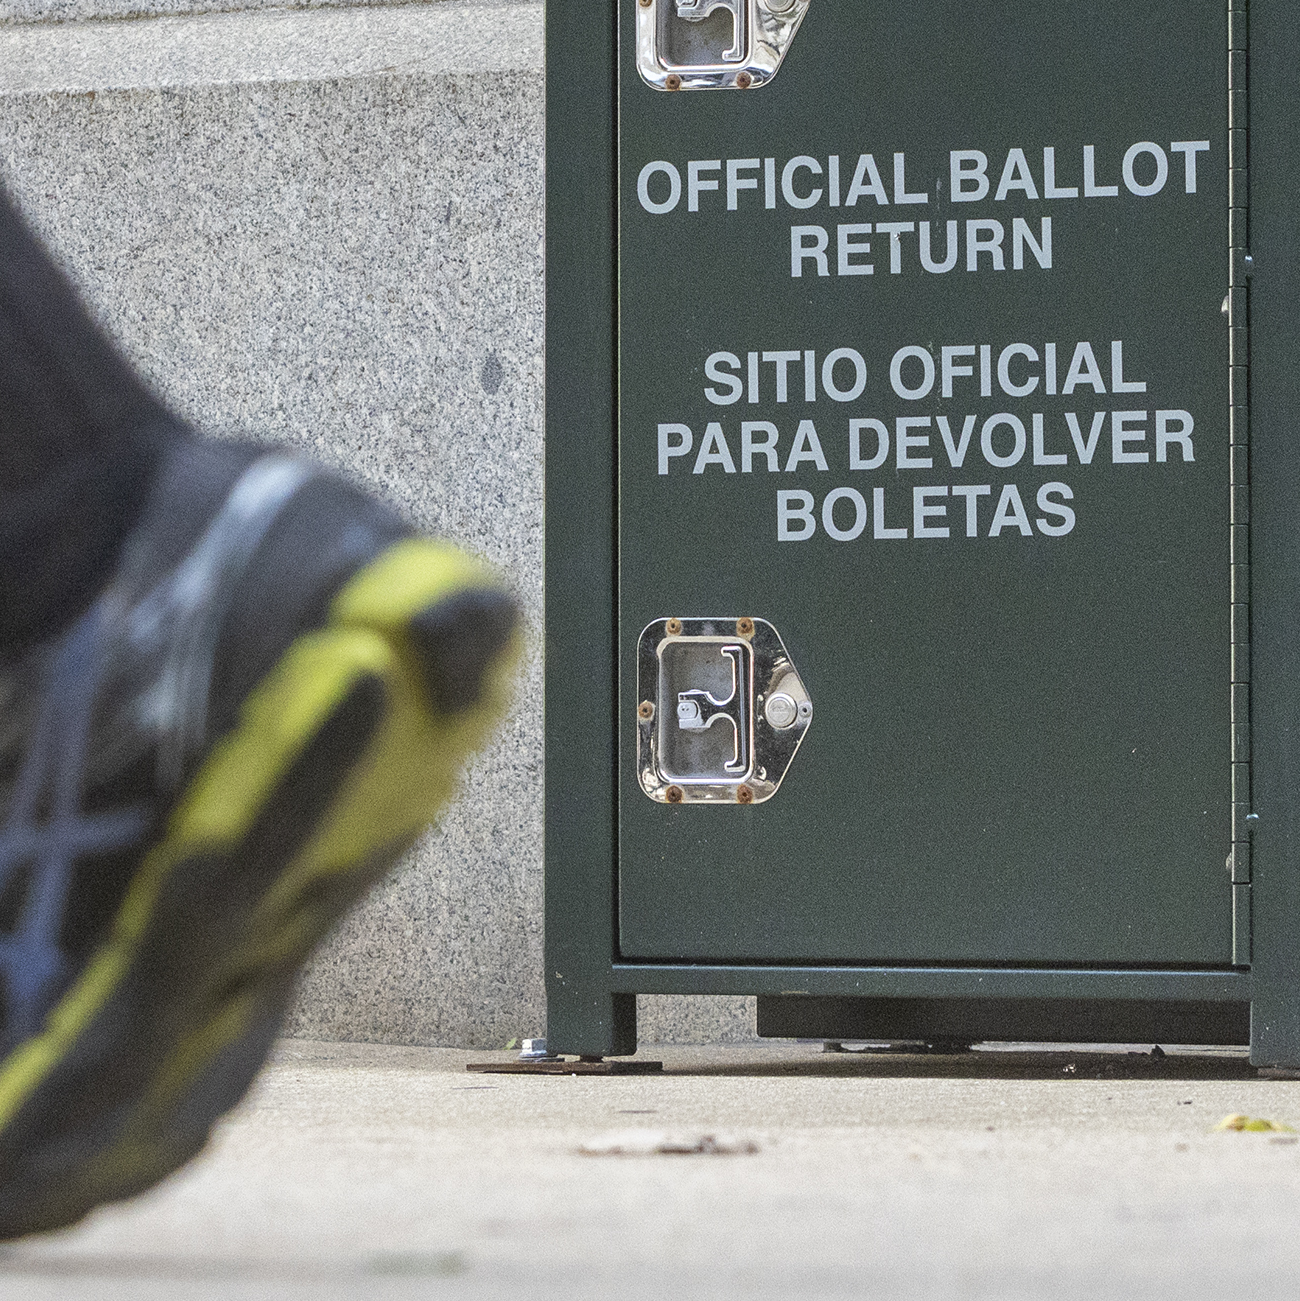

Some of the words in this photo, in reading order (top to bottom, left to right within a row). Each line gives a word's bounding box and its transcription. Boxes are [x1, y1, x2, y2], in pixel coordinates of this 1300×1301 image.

[636, 152, 929, 215] OFFICIAL
[948, 140, 1210, 203] BALLOT
[790, 217, 1053, 278] RETURN
[703, 347, 867, 406] SITIO
[889, 340, 1147, 400] OFICIAL
[656, 419, 829, 475] PARA
[849, 409, 1196, 471] DEVOLVER
[776, 481, 1077, 542] BOLETAS
